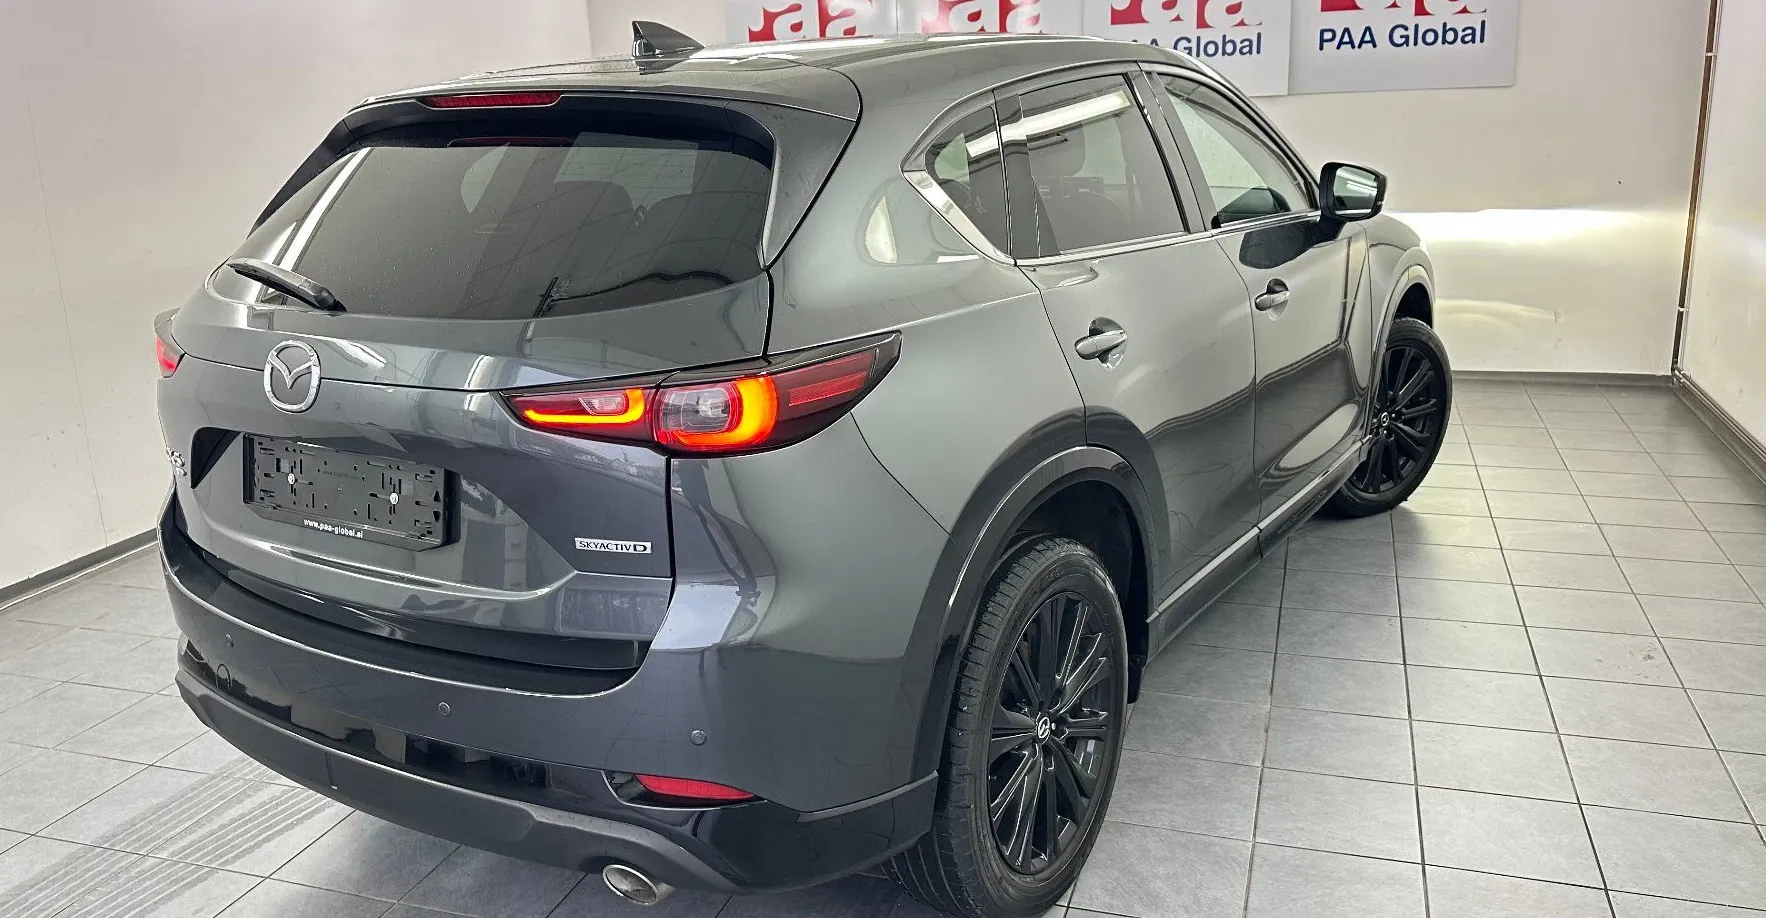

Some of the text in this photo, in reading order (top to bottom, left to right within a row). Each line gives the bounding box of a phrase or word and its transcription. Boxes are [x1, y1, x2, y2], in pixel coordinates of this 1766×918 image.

[1173, 32, 1262, 58] Global
[1318, 19, 1487, 51] PAA Global
[303, 519, 363, 538] www.paa-global.si
